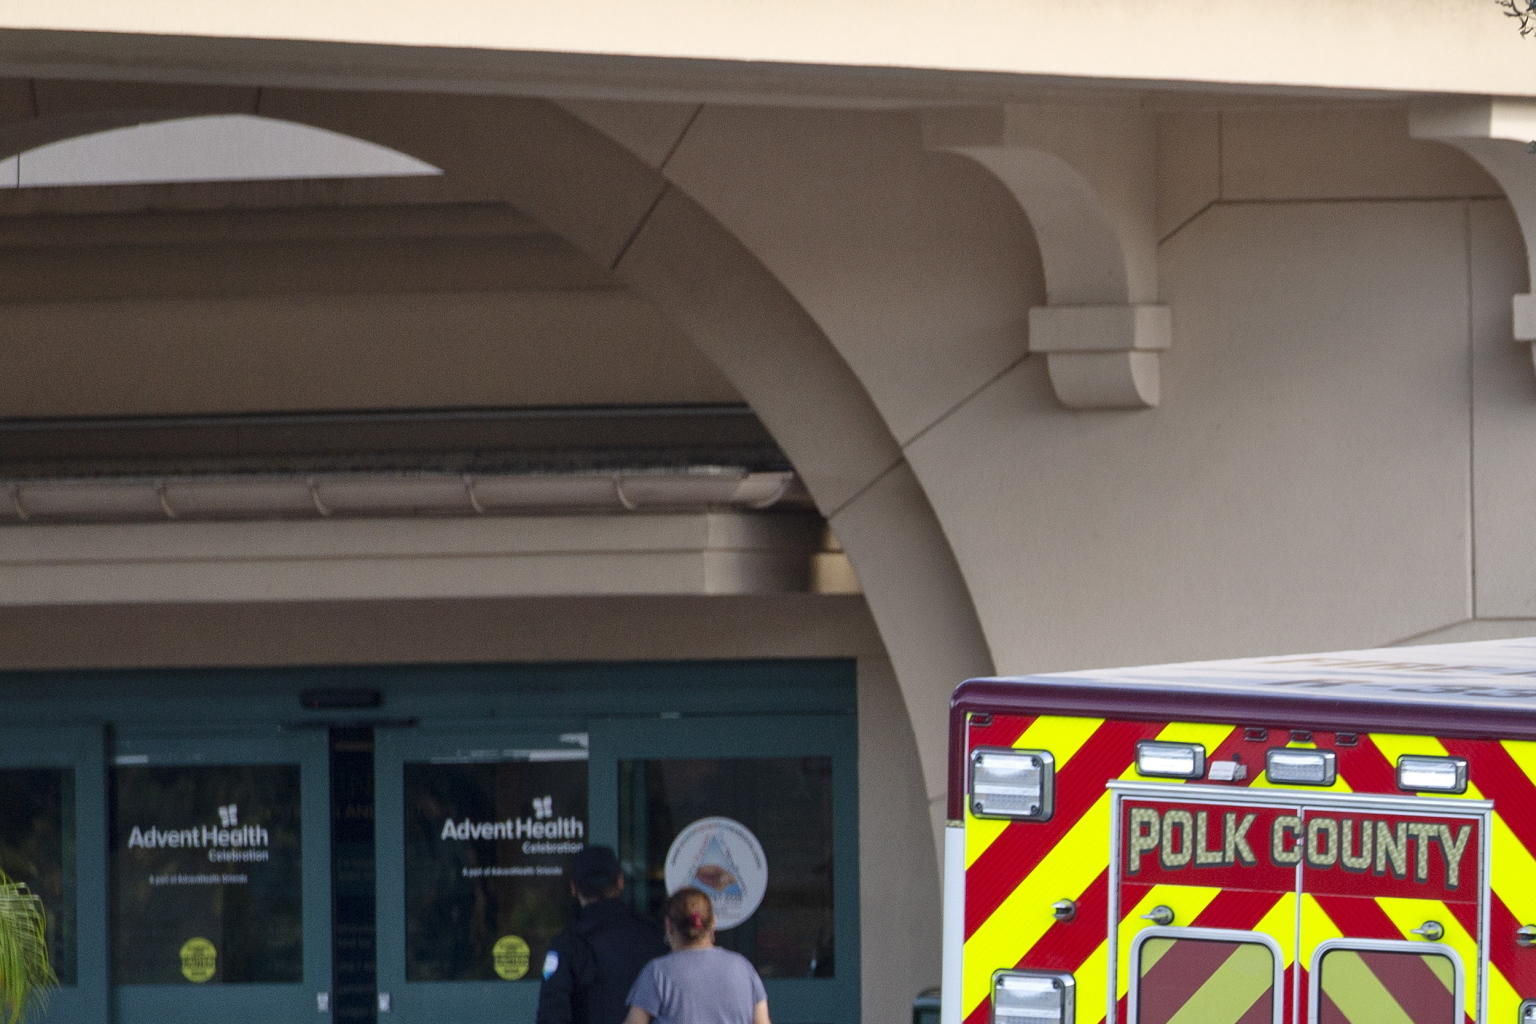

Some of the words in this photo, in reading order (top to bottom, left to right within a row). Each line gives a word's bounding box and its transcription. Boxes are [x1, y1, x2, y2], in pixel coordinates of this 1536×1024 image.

[128, 824, 269, 848] AdventHealth
[441, 816, 584, 840] AdventHealth
[1127, 807, 1256, 875] POLK
[1271, 815, 1472, 891] COUNTY
